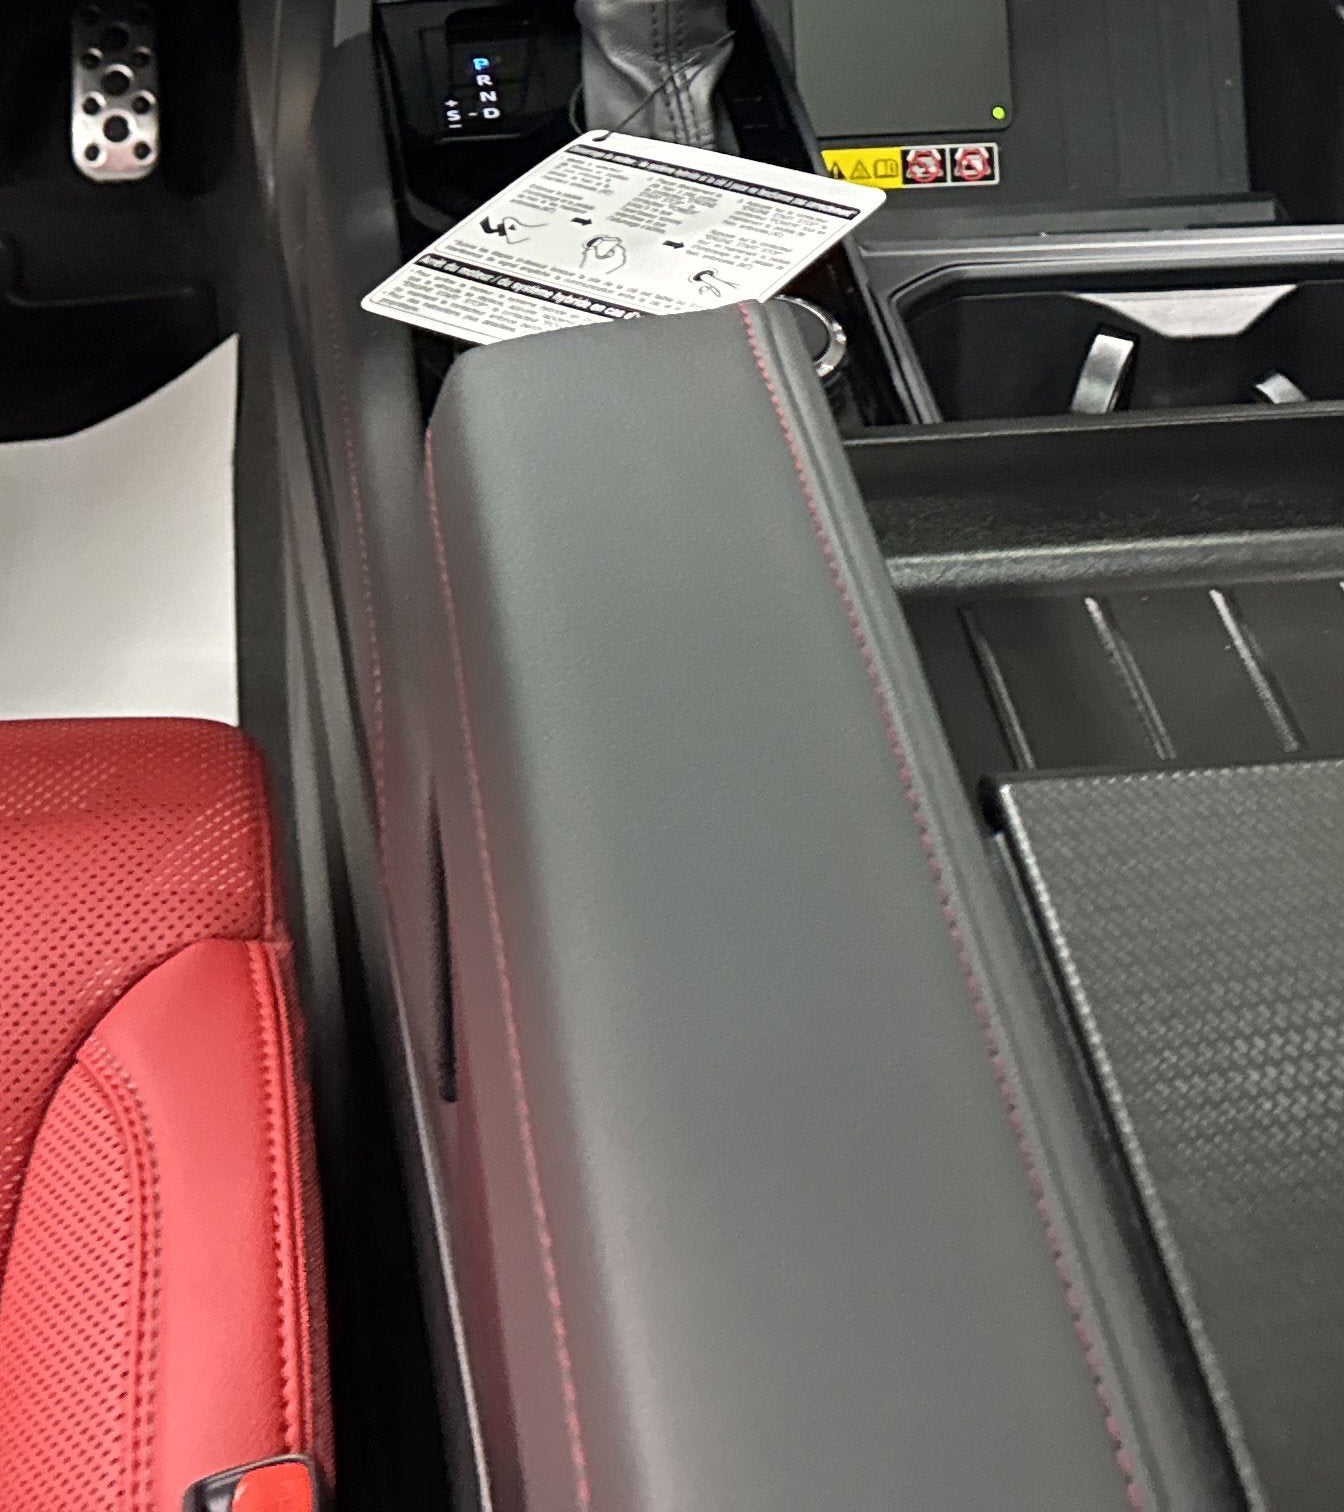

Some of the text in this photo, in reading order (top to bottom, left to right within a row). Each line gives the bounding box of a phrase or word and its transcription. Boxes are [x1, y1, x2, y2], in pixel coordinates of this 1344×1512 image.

[472, 57, 490, 71] P
[476, 74, 493, 86] R
[479, 90, 498, 102] N
[446, 109, 462, 122] S
[482, 107, 501, 119] D
